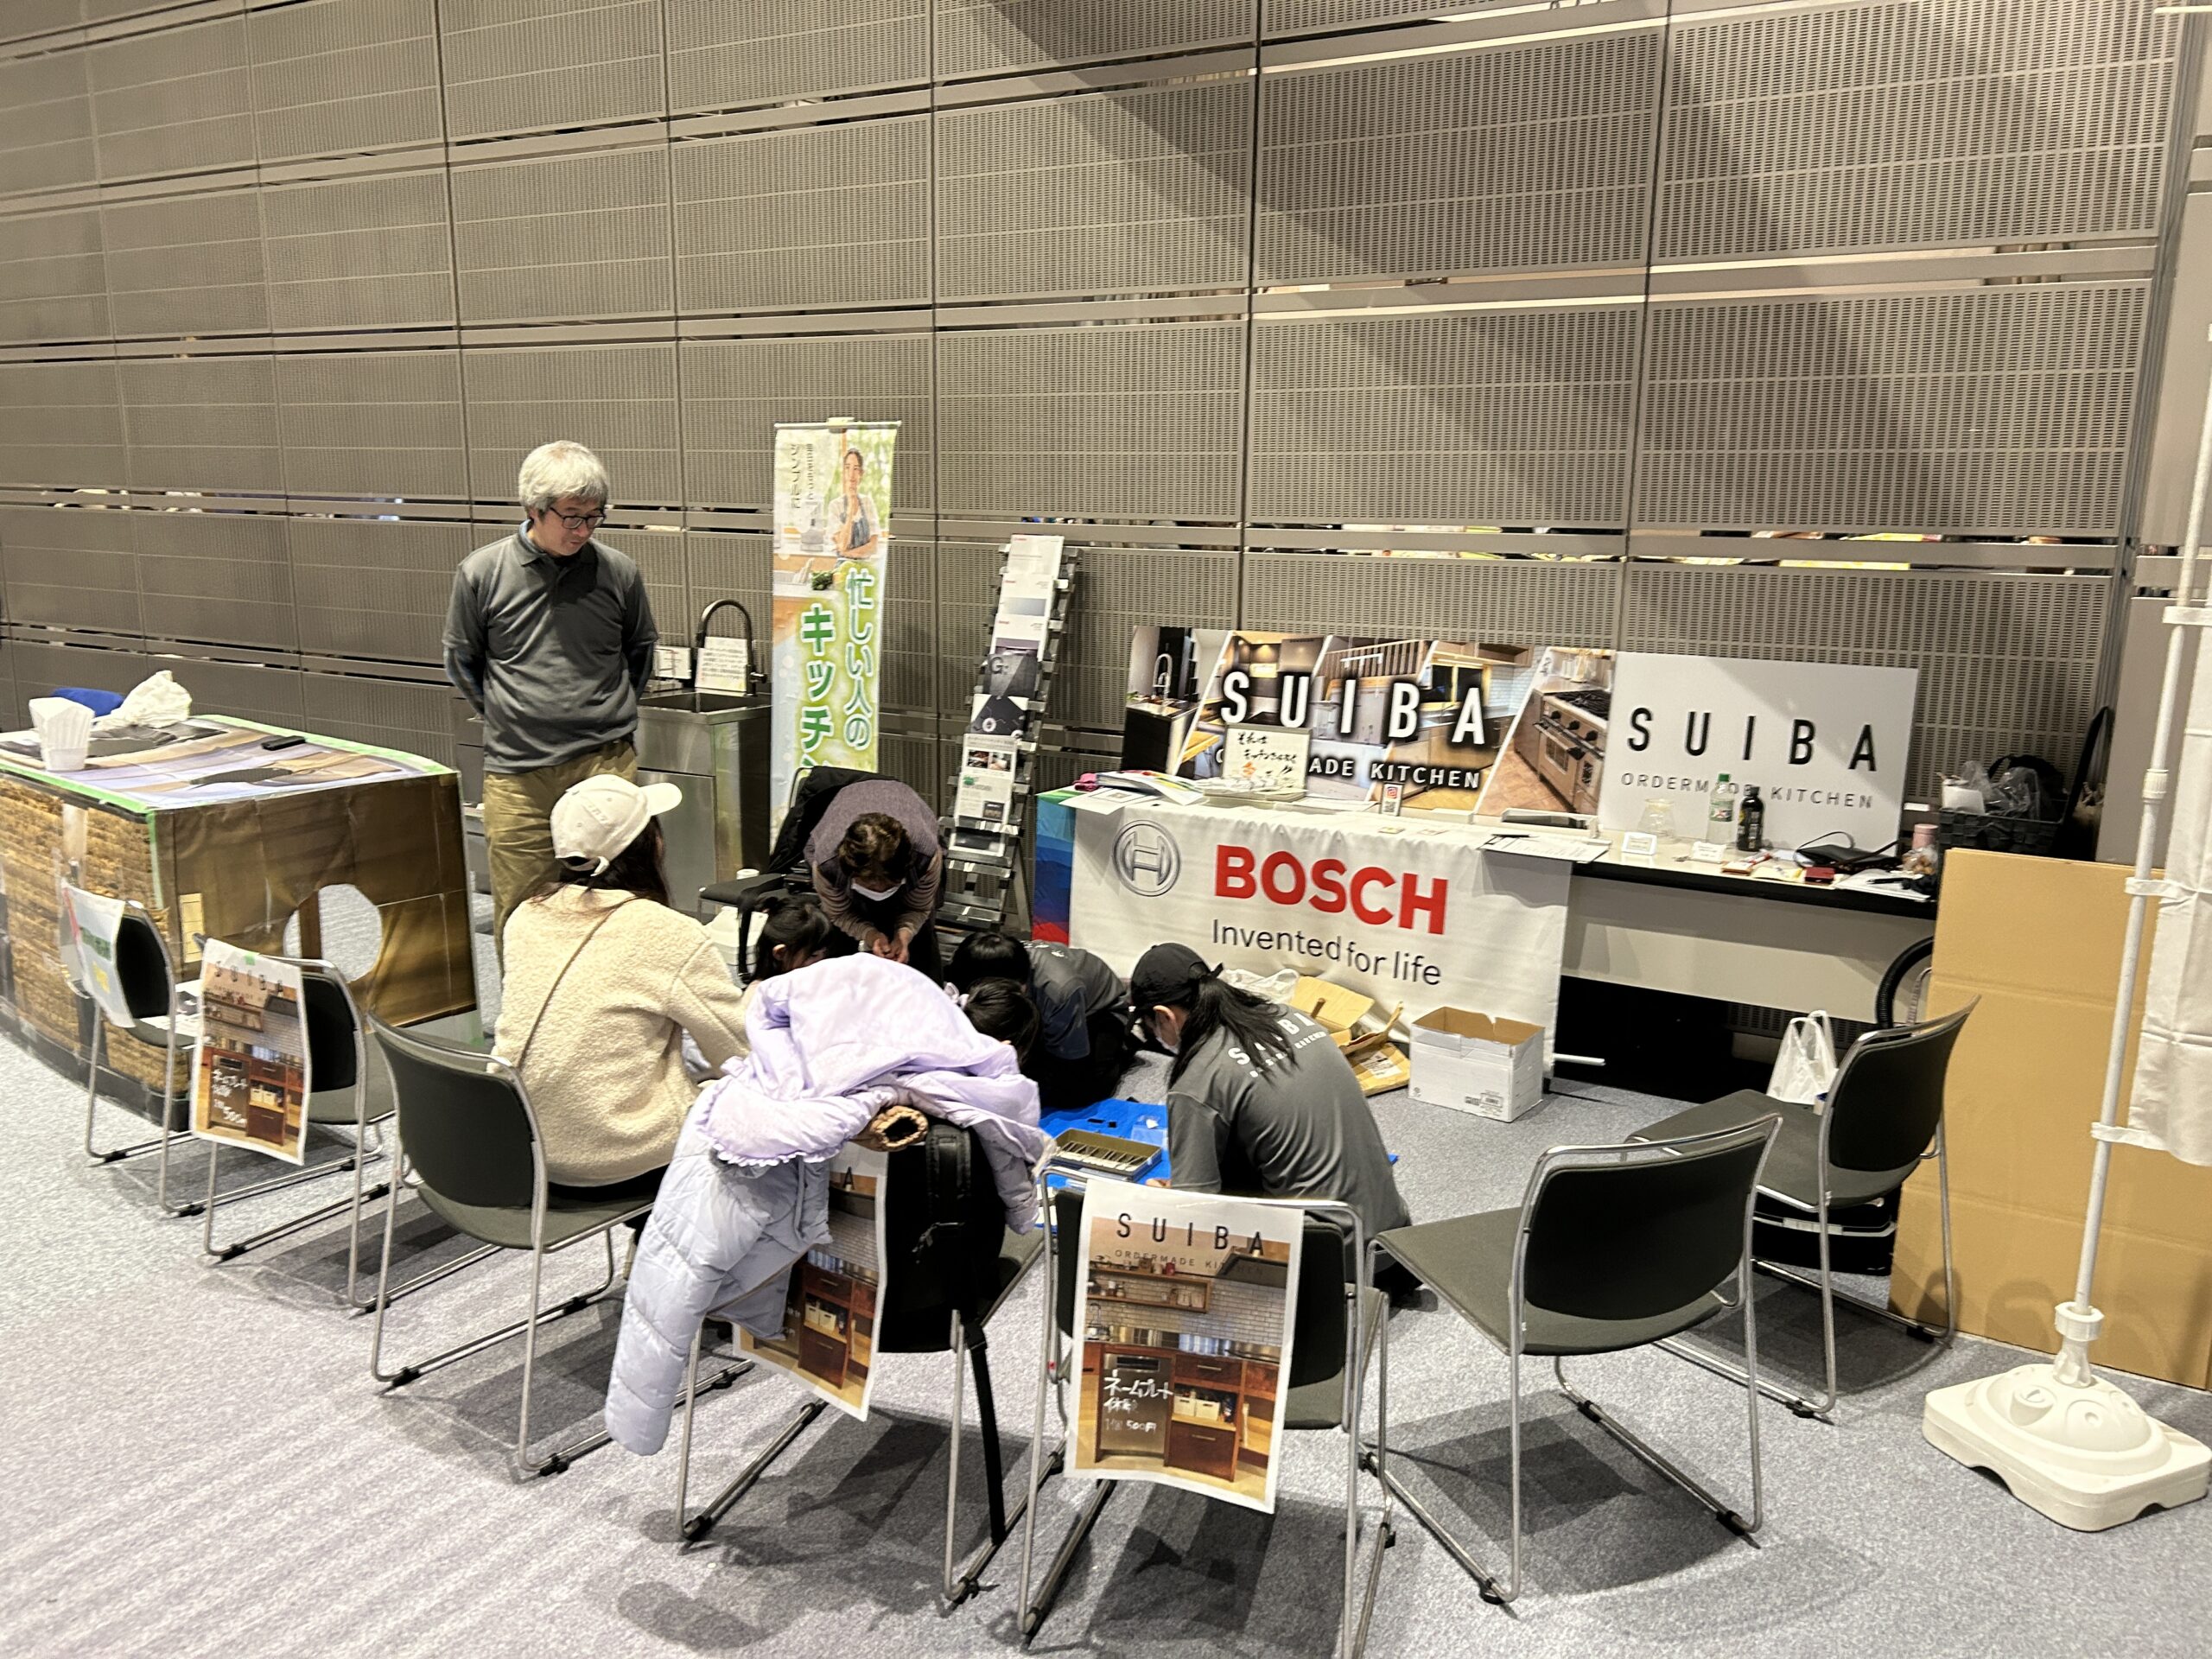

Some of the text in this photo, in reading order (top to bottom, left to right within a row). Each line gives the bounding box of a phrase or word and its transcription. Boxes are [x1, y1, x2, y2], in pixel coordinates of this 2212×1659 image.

[801, 603, 835, 767] キッチ
[846, 568, 873, 749] 忙しい人の
[1220, 671, 1485, 746] SUIBA
[1626, 707, 1878, 772] SUIBA
[1370, 761, 1480, 790] KITCHEN
[1620, 772, 1874, 809] ORDERMDE KITCHEN
[1214, 843, 1449, 936] BOSCH
[1212, 918, 1442, 986] Invented for life
[1116, 1212, 1264, 1256] SUIBA
